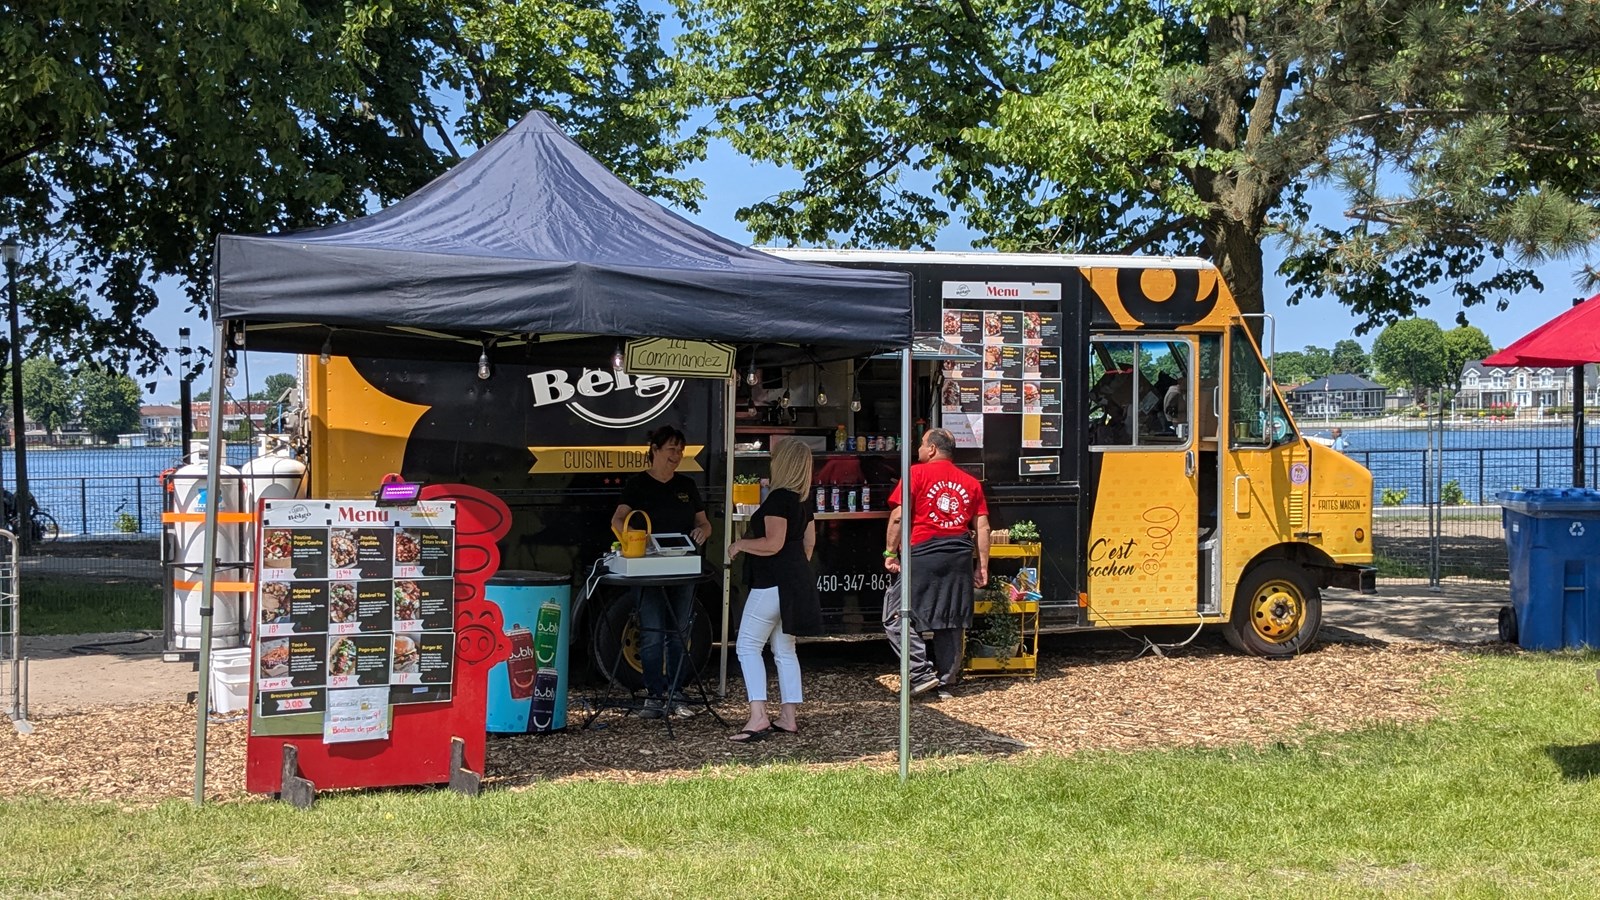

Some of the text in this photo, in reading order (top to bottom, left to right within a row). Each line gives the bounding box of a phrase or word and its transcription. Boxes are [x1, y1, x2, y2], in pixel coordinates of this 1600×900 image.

[987, 286, 1019, 297] Menu
[638, 350, 722, 369] Commandez
[527, 369, 671, 407] Belg
[564, 451, 652, 469] CUISINE URBA
[1318, 499, 1360, 510] FRITES MAISON
[338, 507, 389, 522] Menu
[1089, 538, 1138, 562] C'est
[1087, 560, 1136, 578] cochon
[817, 573, 892, 592] 450-347-863
[534, 686, 555, 701] bubly
